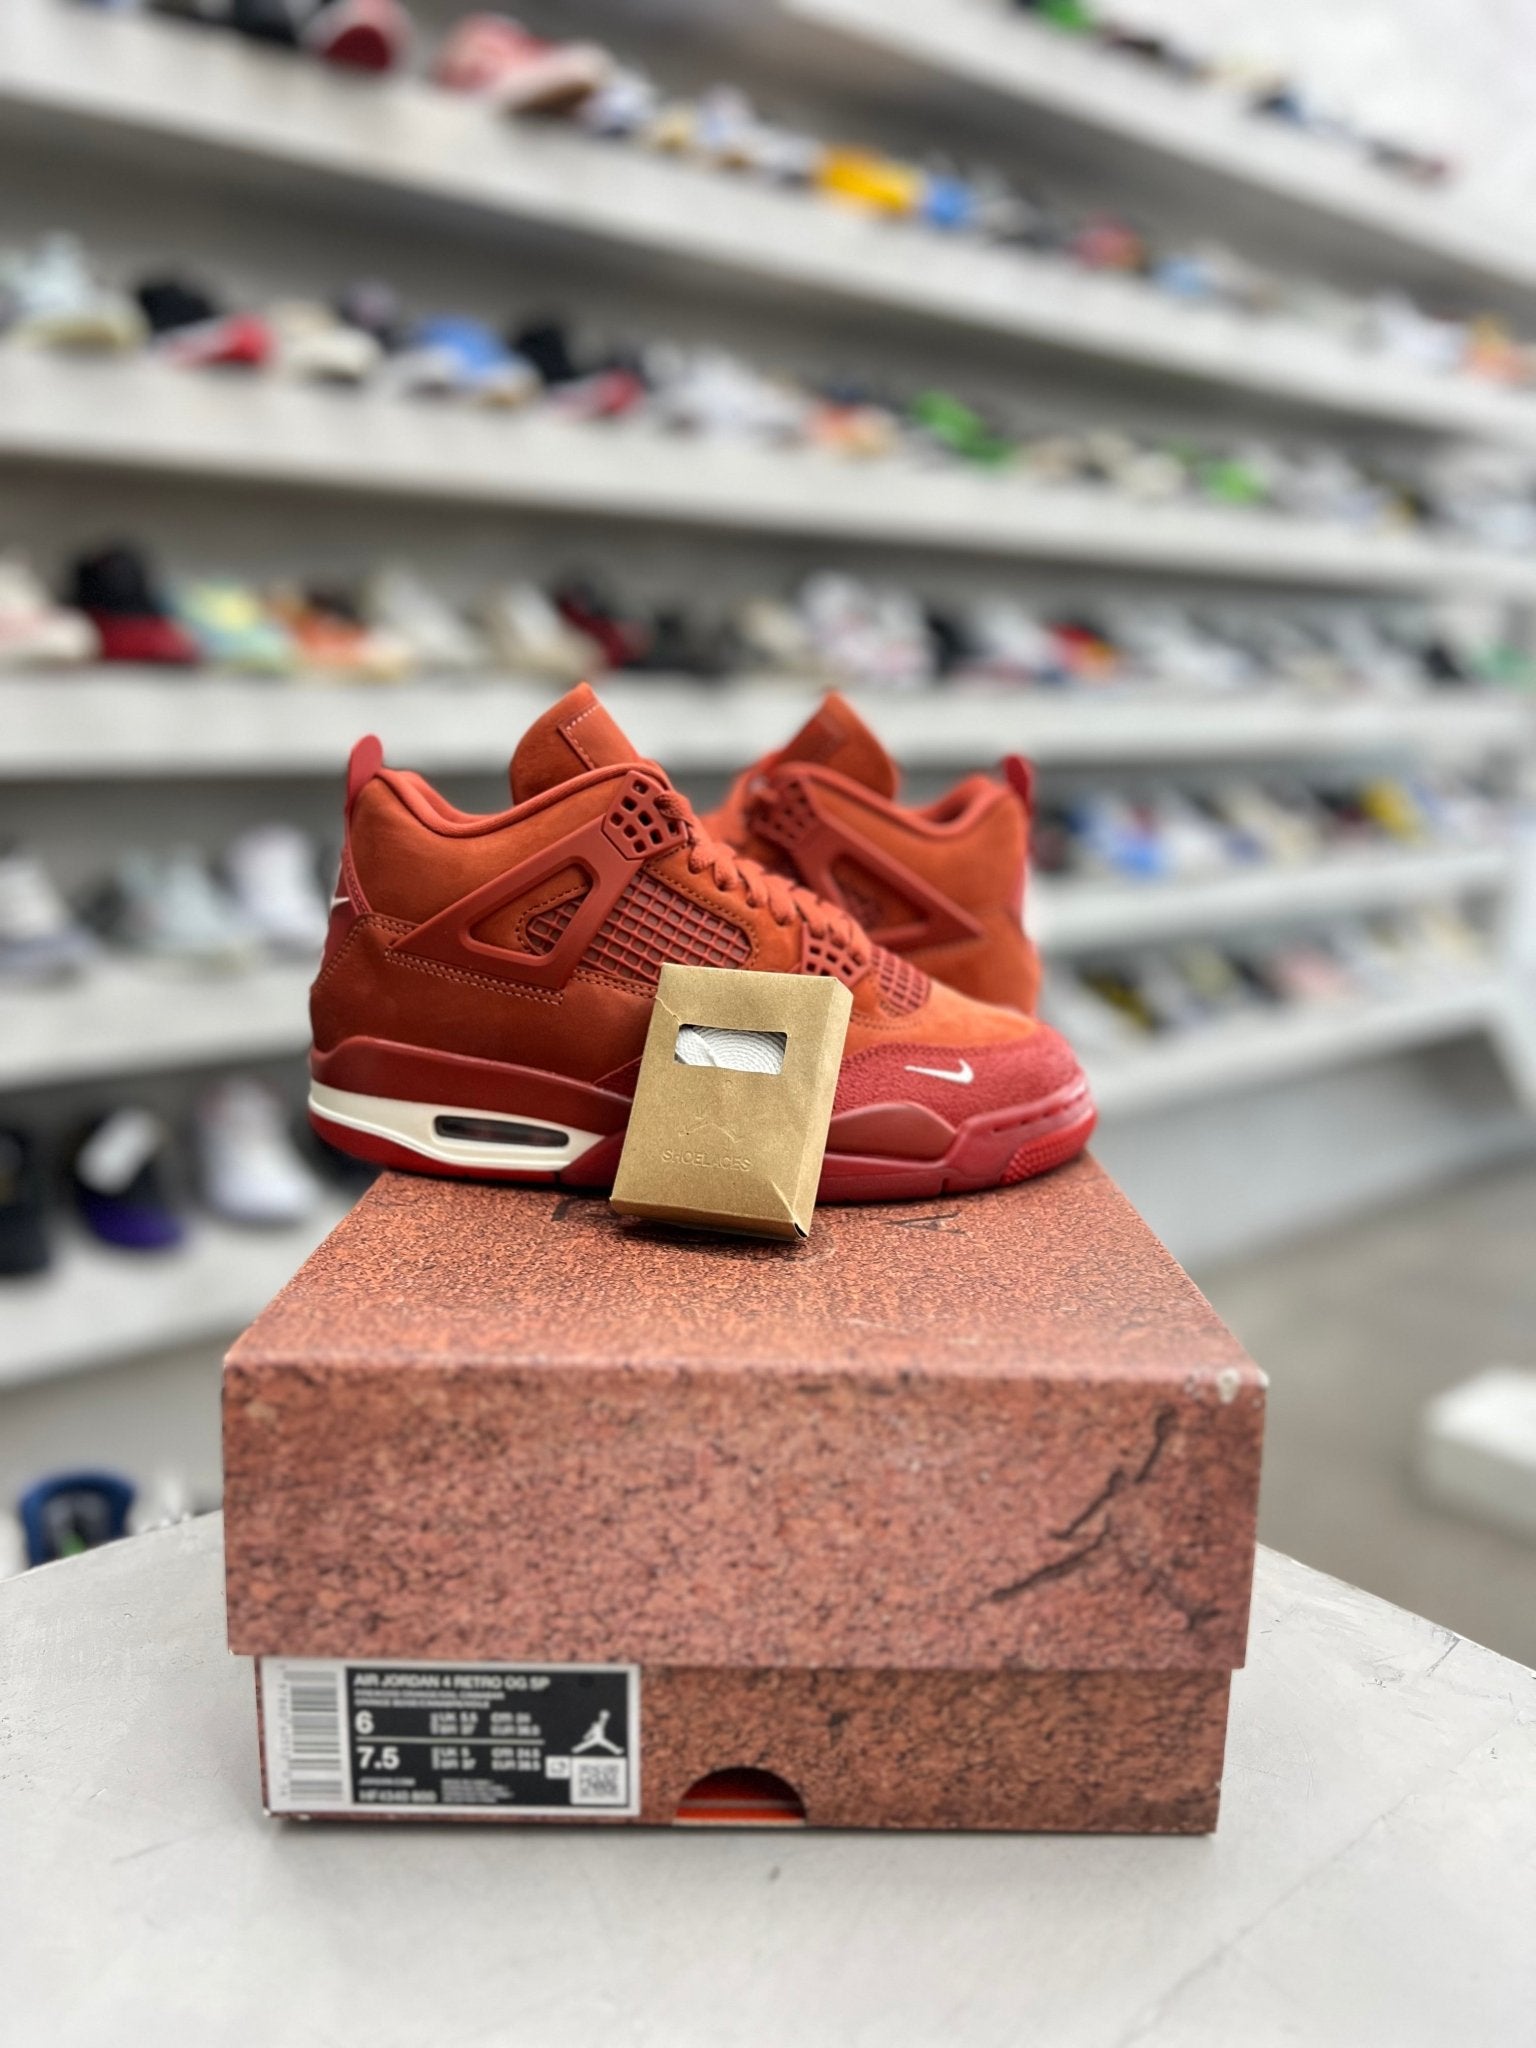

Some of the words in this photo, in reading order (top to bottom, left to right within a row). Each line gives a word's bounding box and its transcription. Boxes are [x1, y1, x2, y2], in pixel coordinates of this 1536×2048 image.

[661, 1150, 752, 1172] SHOELACES
[354, 1673, 379, 1687] AIR
[381, 1673, 440, 1688] JORDAN
[442, 1674, 451, 1688] 4
[453, 1674, 502, 1690] RETRO
[504, 1675, 528, 1690] OG
[354, 1710, 375, 1735] 6
[356, 1746, 400, 1770] 7.5
